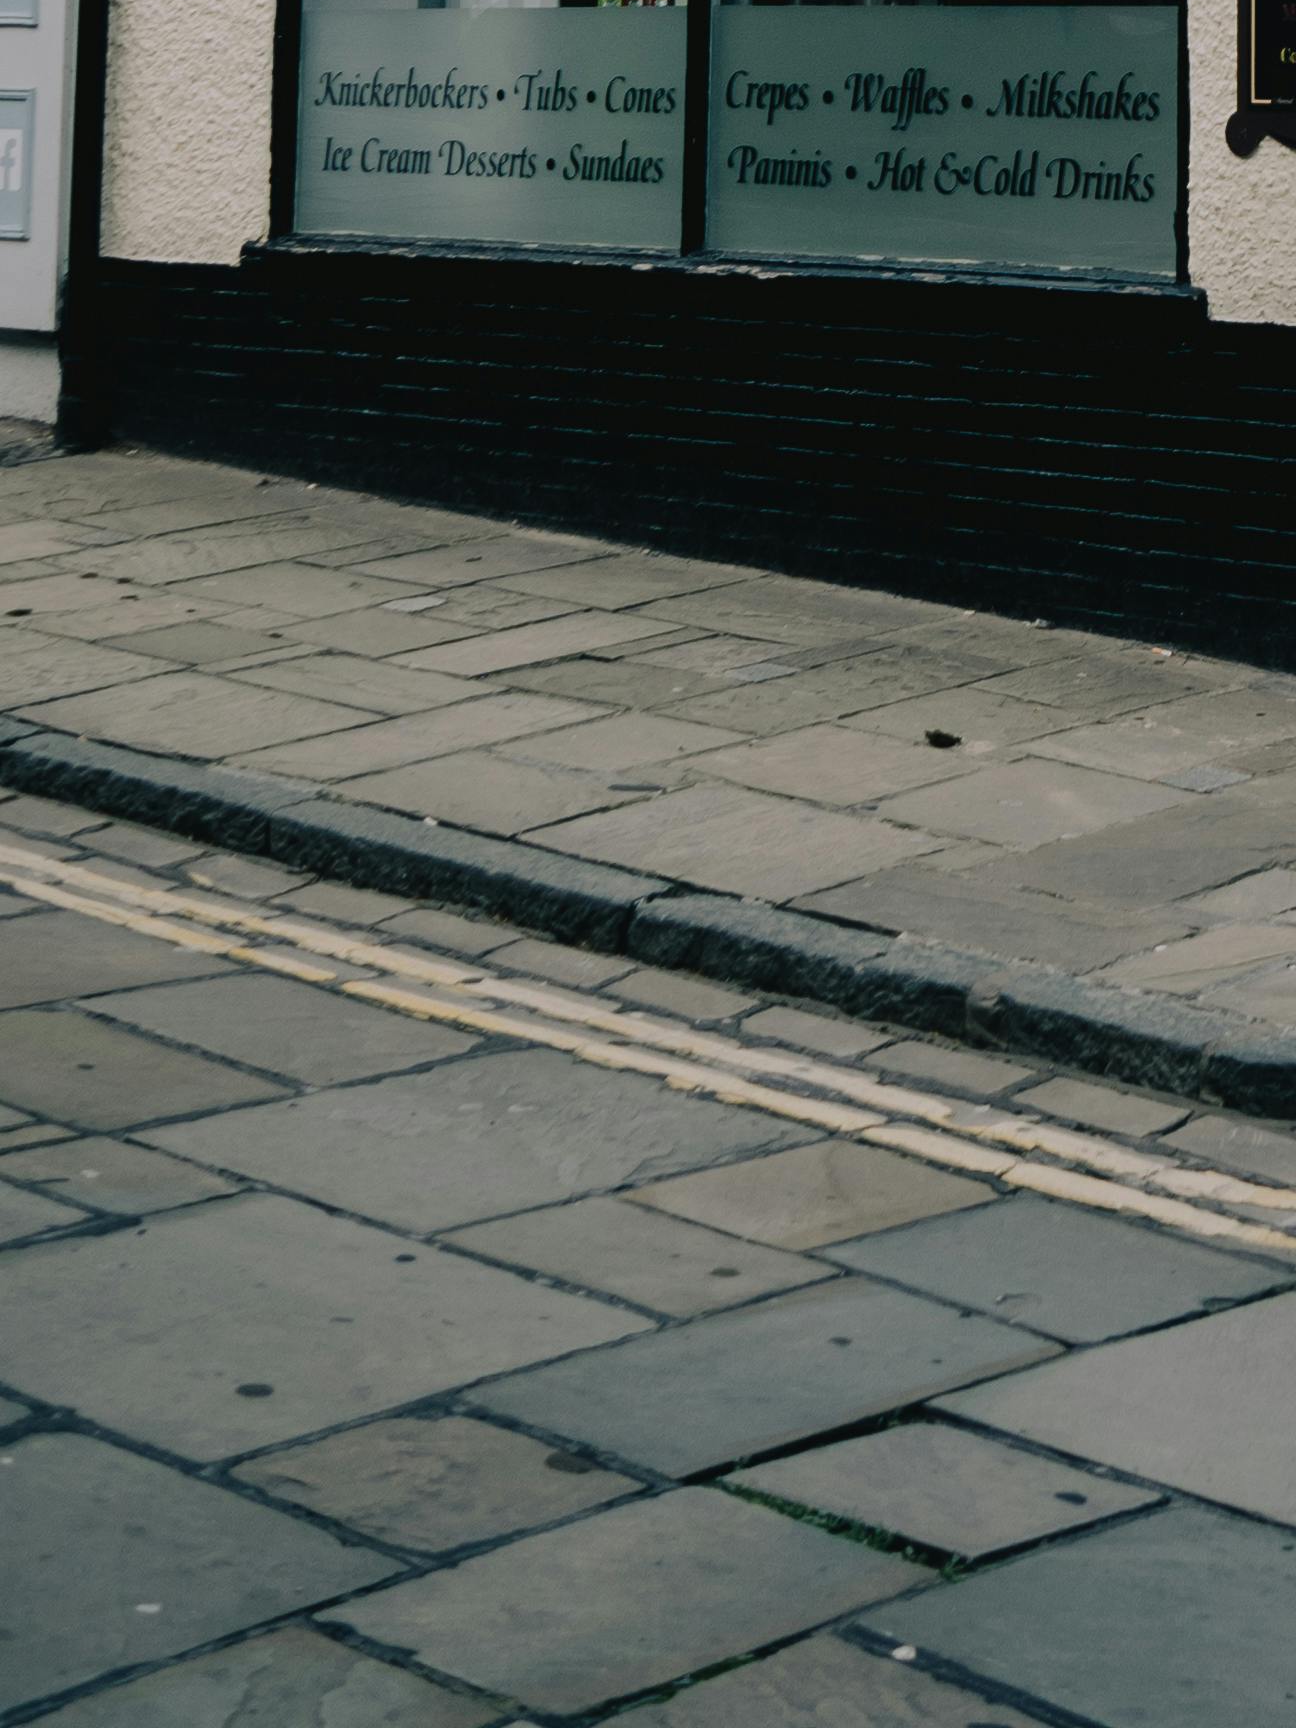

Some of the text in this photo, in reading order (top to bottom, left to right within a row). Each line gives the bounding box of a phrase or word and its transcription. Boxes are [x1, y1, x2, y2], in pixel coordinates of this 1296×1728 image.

[314, 67, 676, 114] Knickerbockers Tubs Cones
[725, 67, 1160, 131] Crepes Waffles Milkshakes
[322, 136, 664, 184] Ice Cream Desserts Sundaes
[728, 144, 1156, 203] Paninis Hot & Cold Drinks
